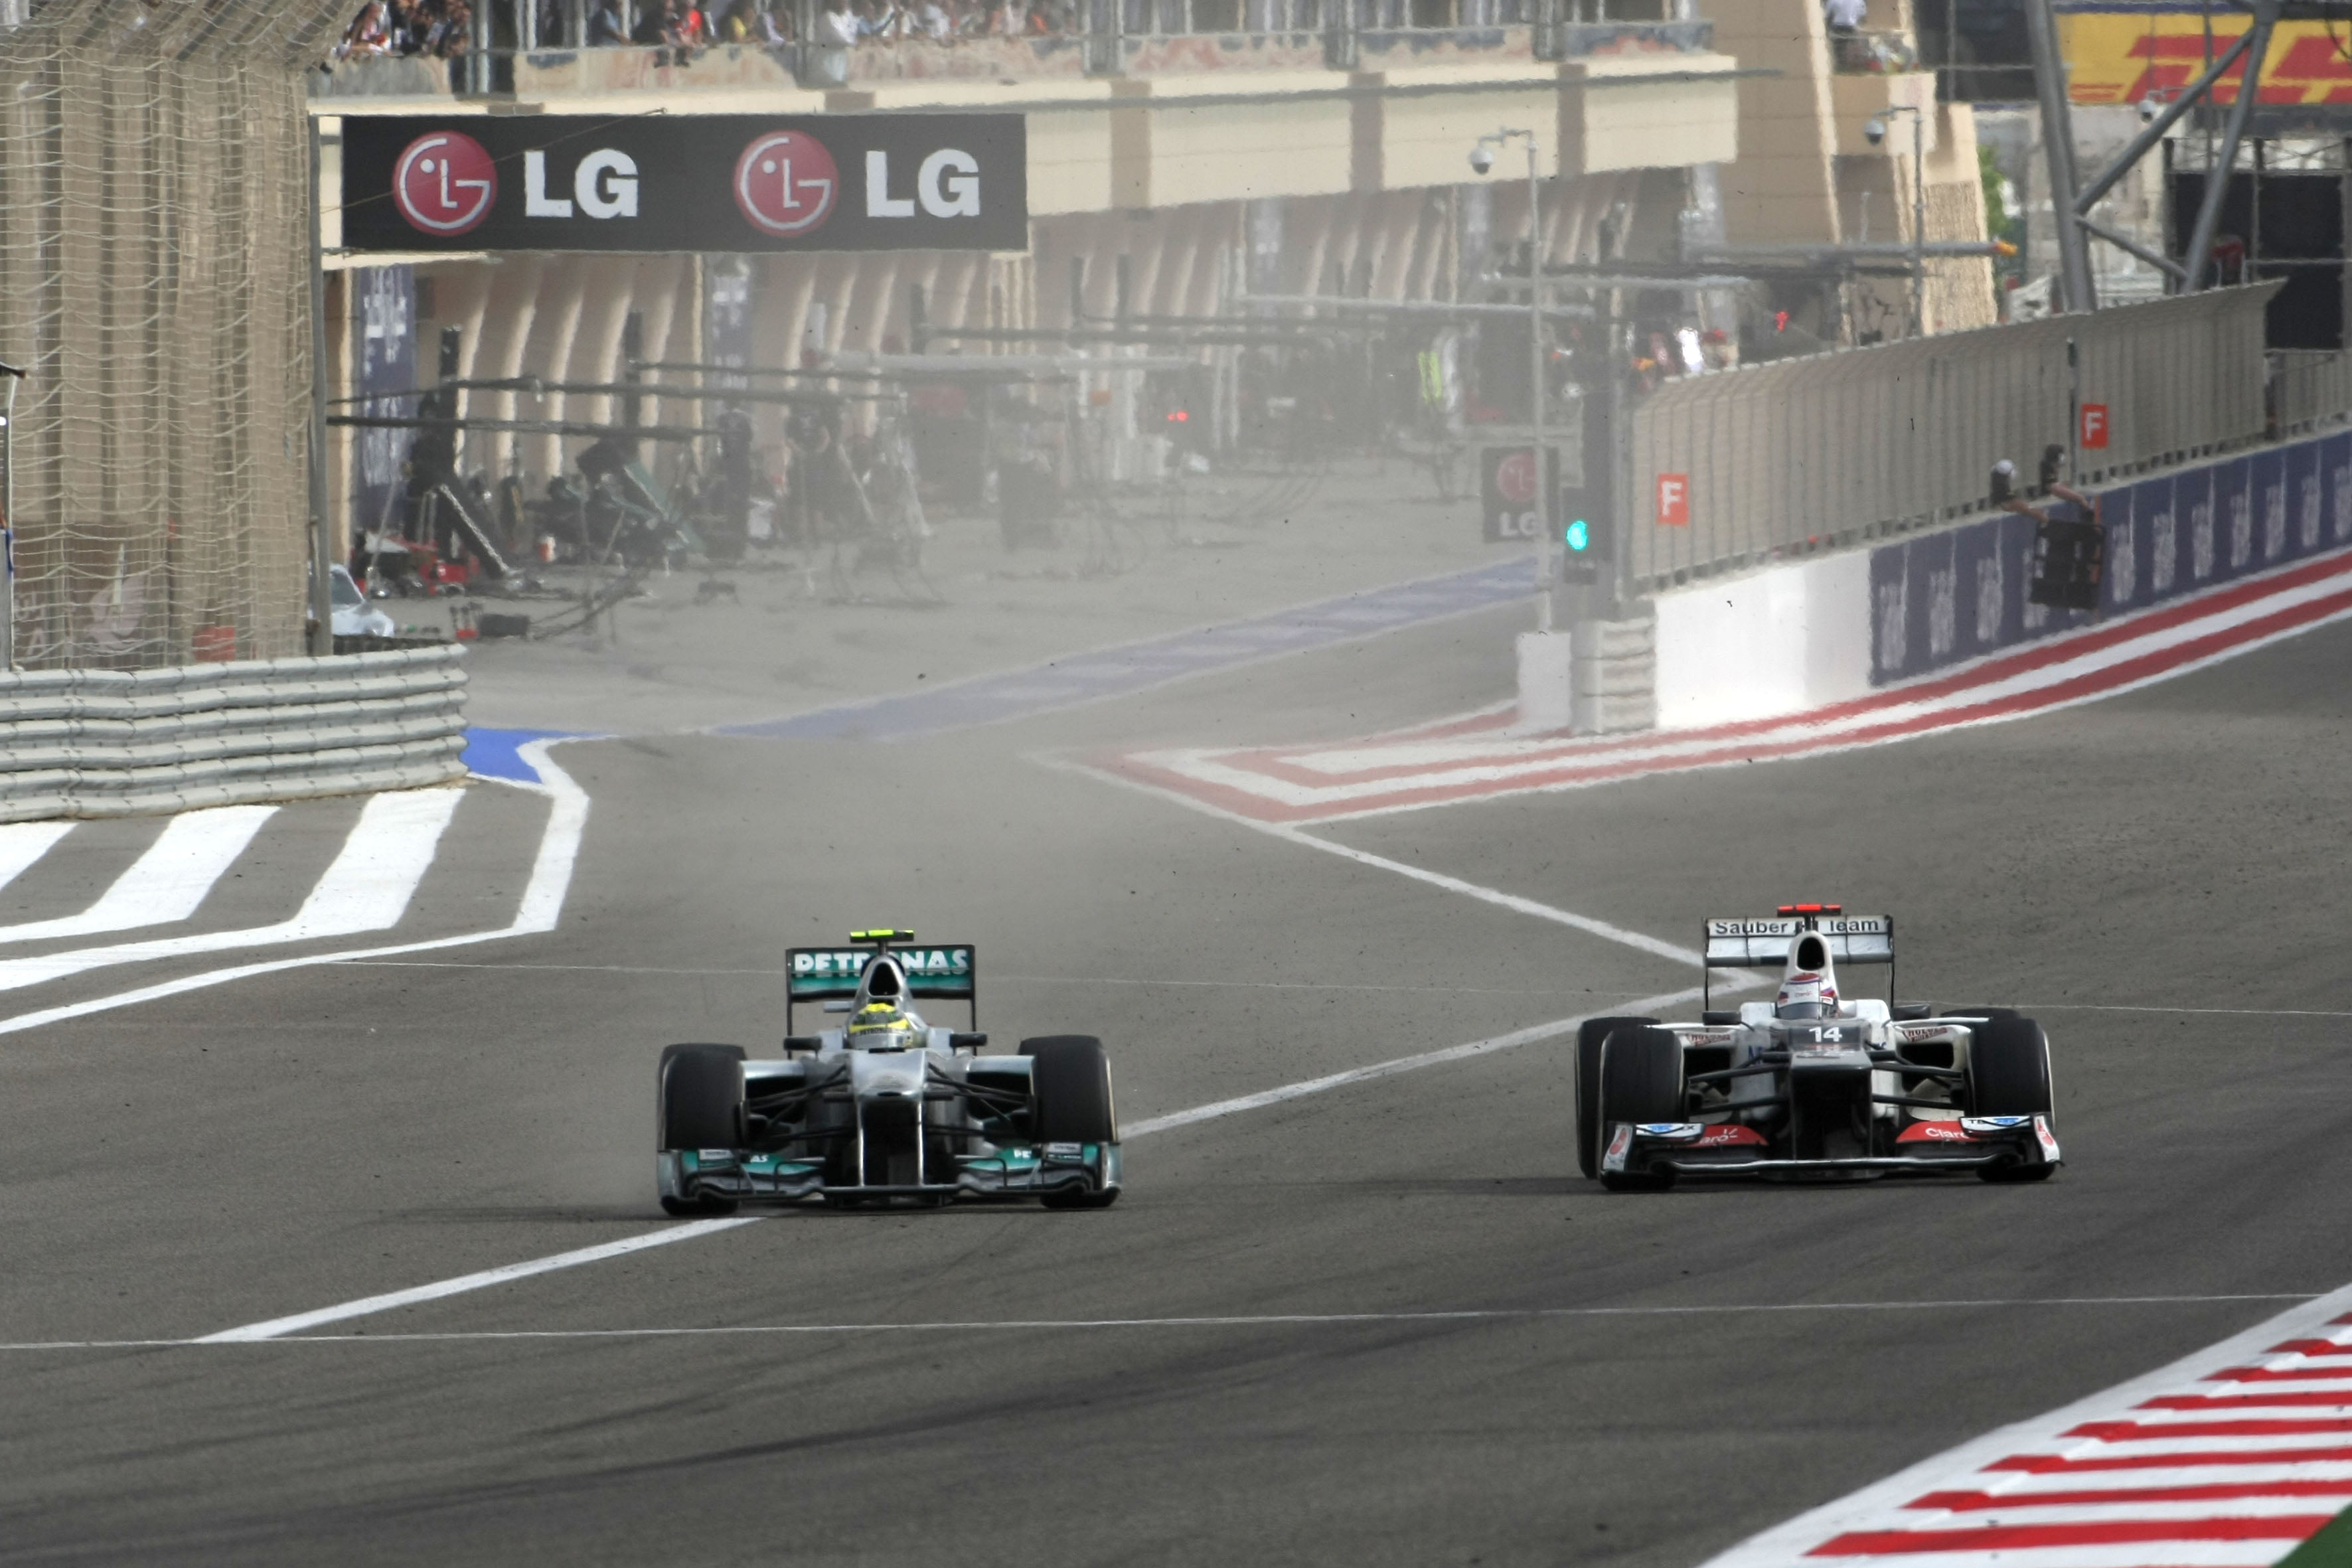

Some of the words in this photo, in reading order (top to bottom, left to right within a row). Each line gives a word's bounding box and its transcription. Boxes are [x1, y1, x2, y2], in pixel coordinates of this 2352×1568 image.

[524, 148, 639, 219] LG
[866, 148, 980, 218] LG
[2086, 412, 2103, 441] F
[1661, 480, 1682, 516] F
[1715, 921, 1788, 935] Sauber
[794, 949, 969, 977] PETRNAS
[1808, 1027, 1843, 1043] 14
